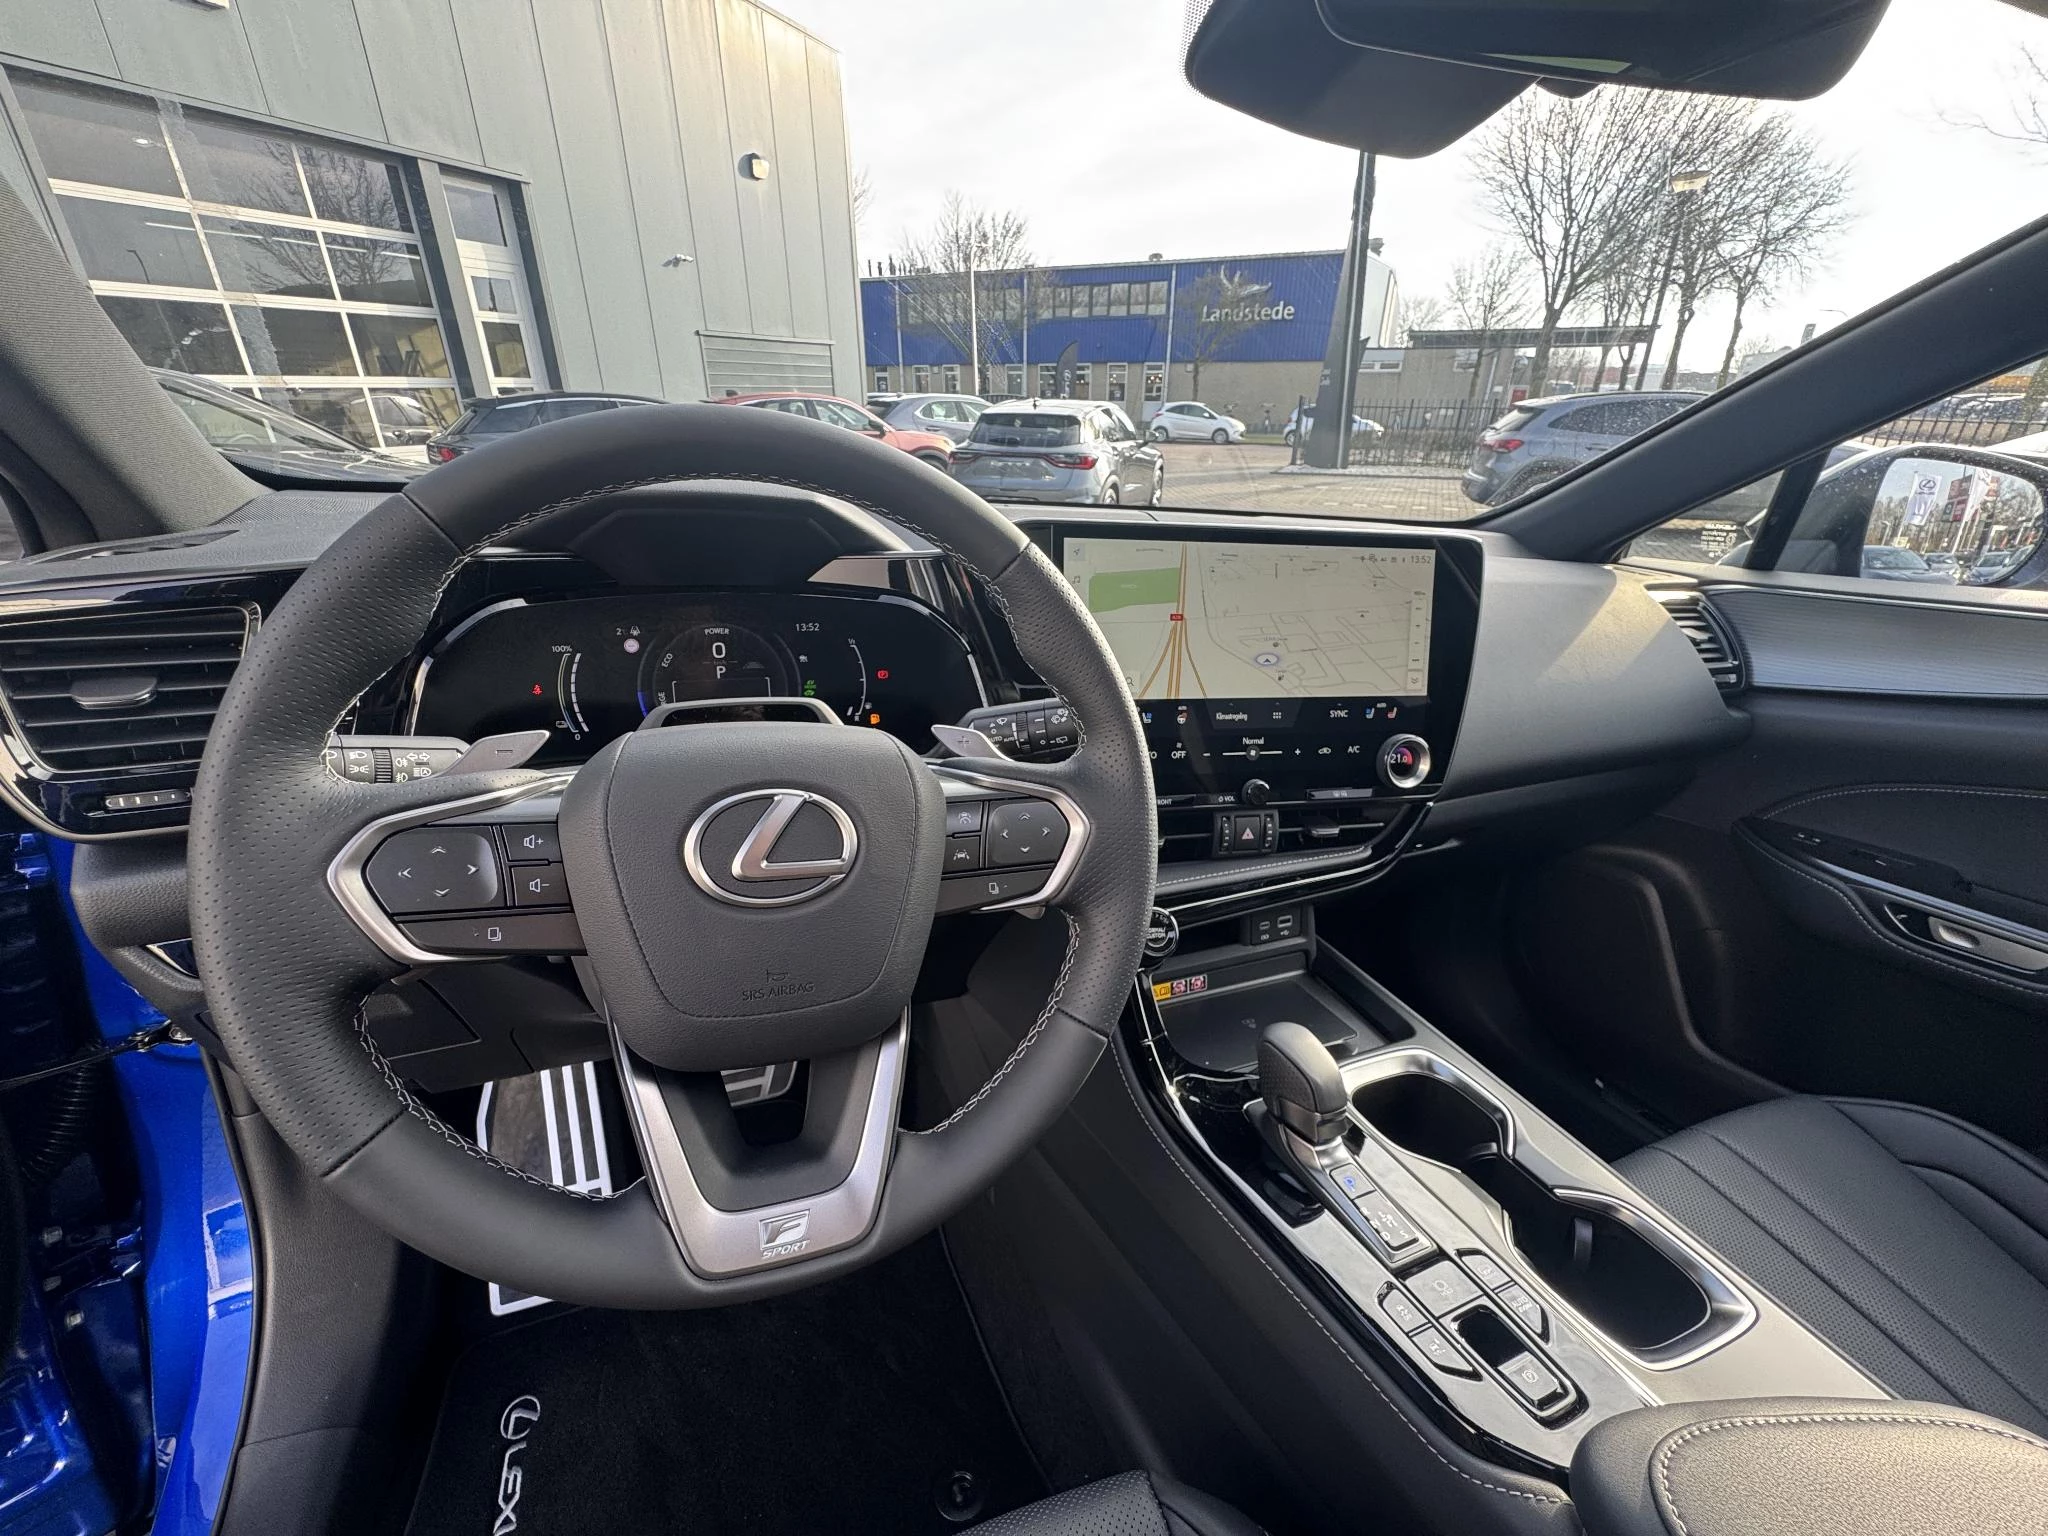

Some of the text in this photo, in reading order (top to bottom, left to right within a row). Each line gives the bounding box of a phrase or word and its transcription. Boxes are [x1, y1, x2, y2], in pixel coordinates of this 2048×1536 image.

[1202, 301, 1295, 321] Landstede
[1411, 555, 1432, 564] 13:52
[796, 623, 820, 631] 13:52
[552, 645, 572, 653] 100%
[661, 653, 673, 667] ECO
[716, 666, 726, 679] P
[1329, 710, 1349, 718] SYNC
[1242, 737, 1264, 745] Normal
[1171, 751, 1187, 759] OFF
[742, 982, 815, 1001] SRS AIRBAG
[762, 1240, 810, 1259] SPORT
[492, 1440, 523, 1536] LEX
